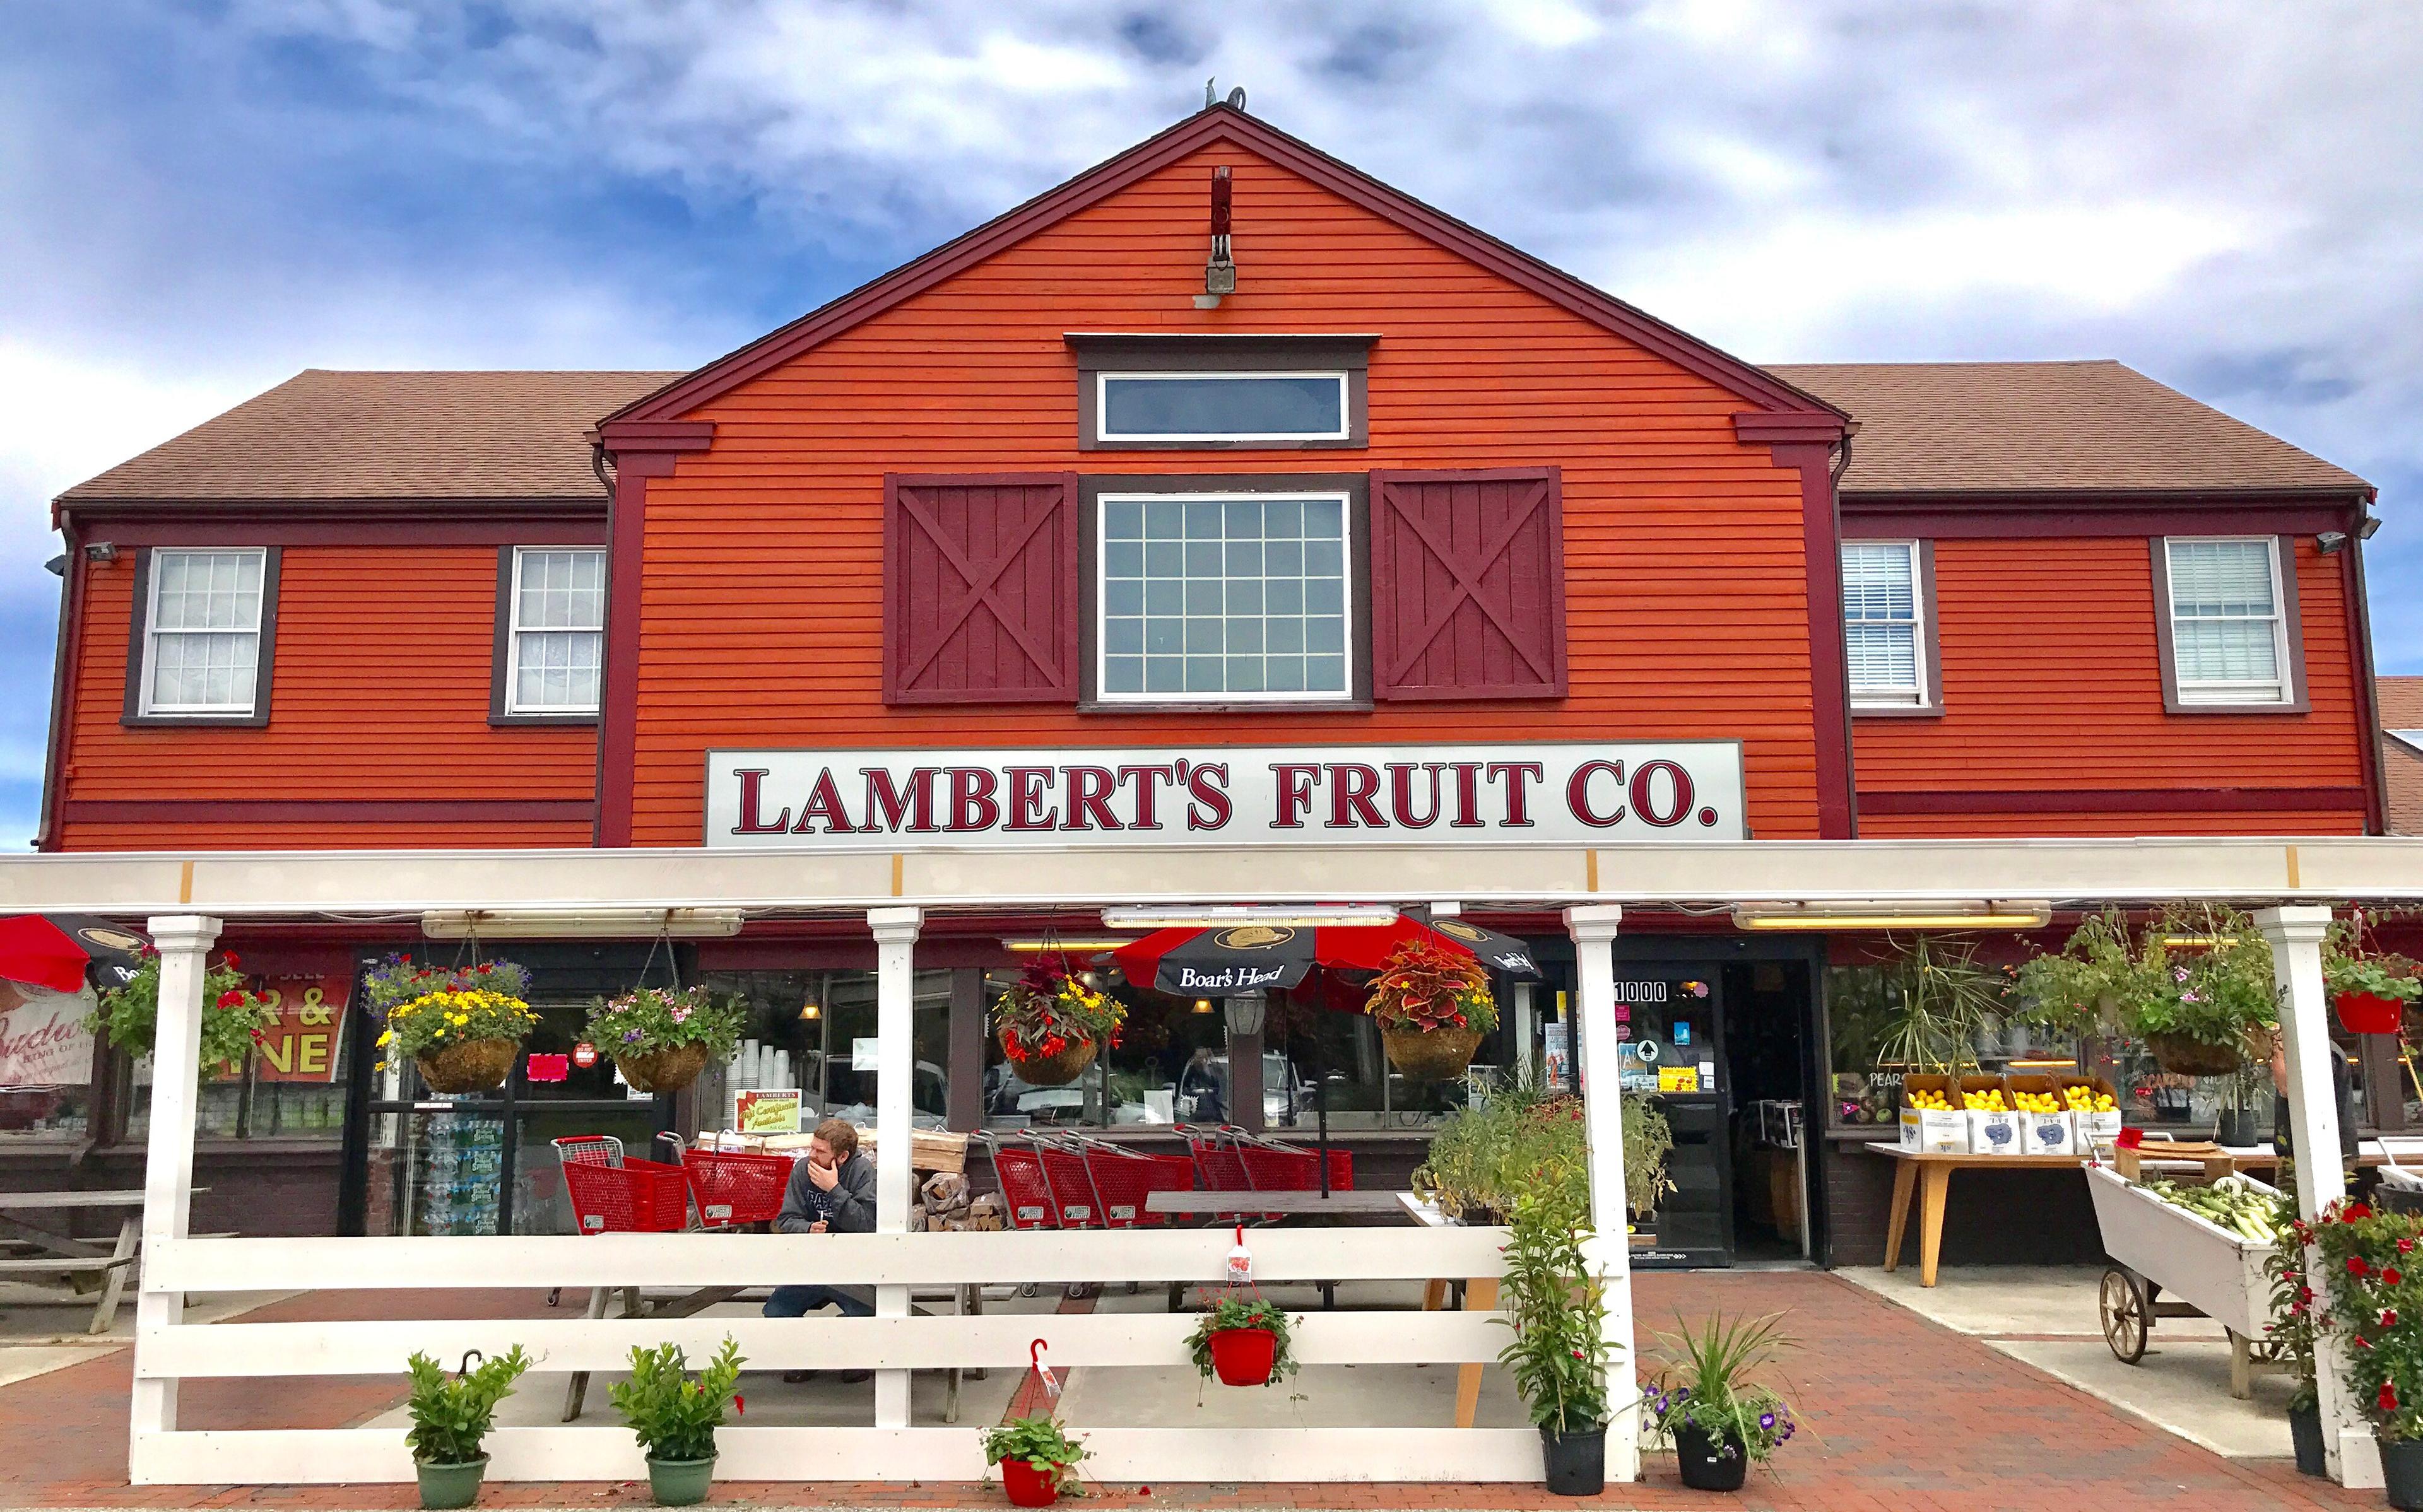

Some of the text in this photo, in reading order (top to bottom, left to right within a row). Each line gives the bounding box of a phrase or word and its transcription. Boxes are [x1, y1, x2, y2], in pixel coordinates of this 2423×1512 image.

[731, 758, 1719, 834] LAMBERT'S FRUIT CO.
[1179, 964, 1285, 987] Boar's Head
[1615, 982, 1665, 1000] 1000
[300, 987, 332, 1026] &
